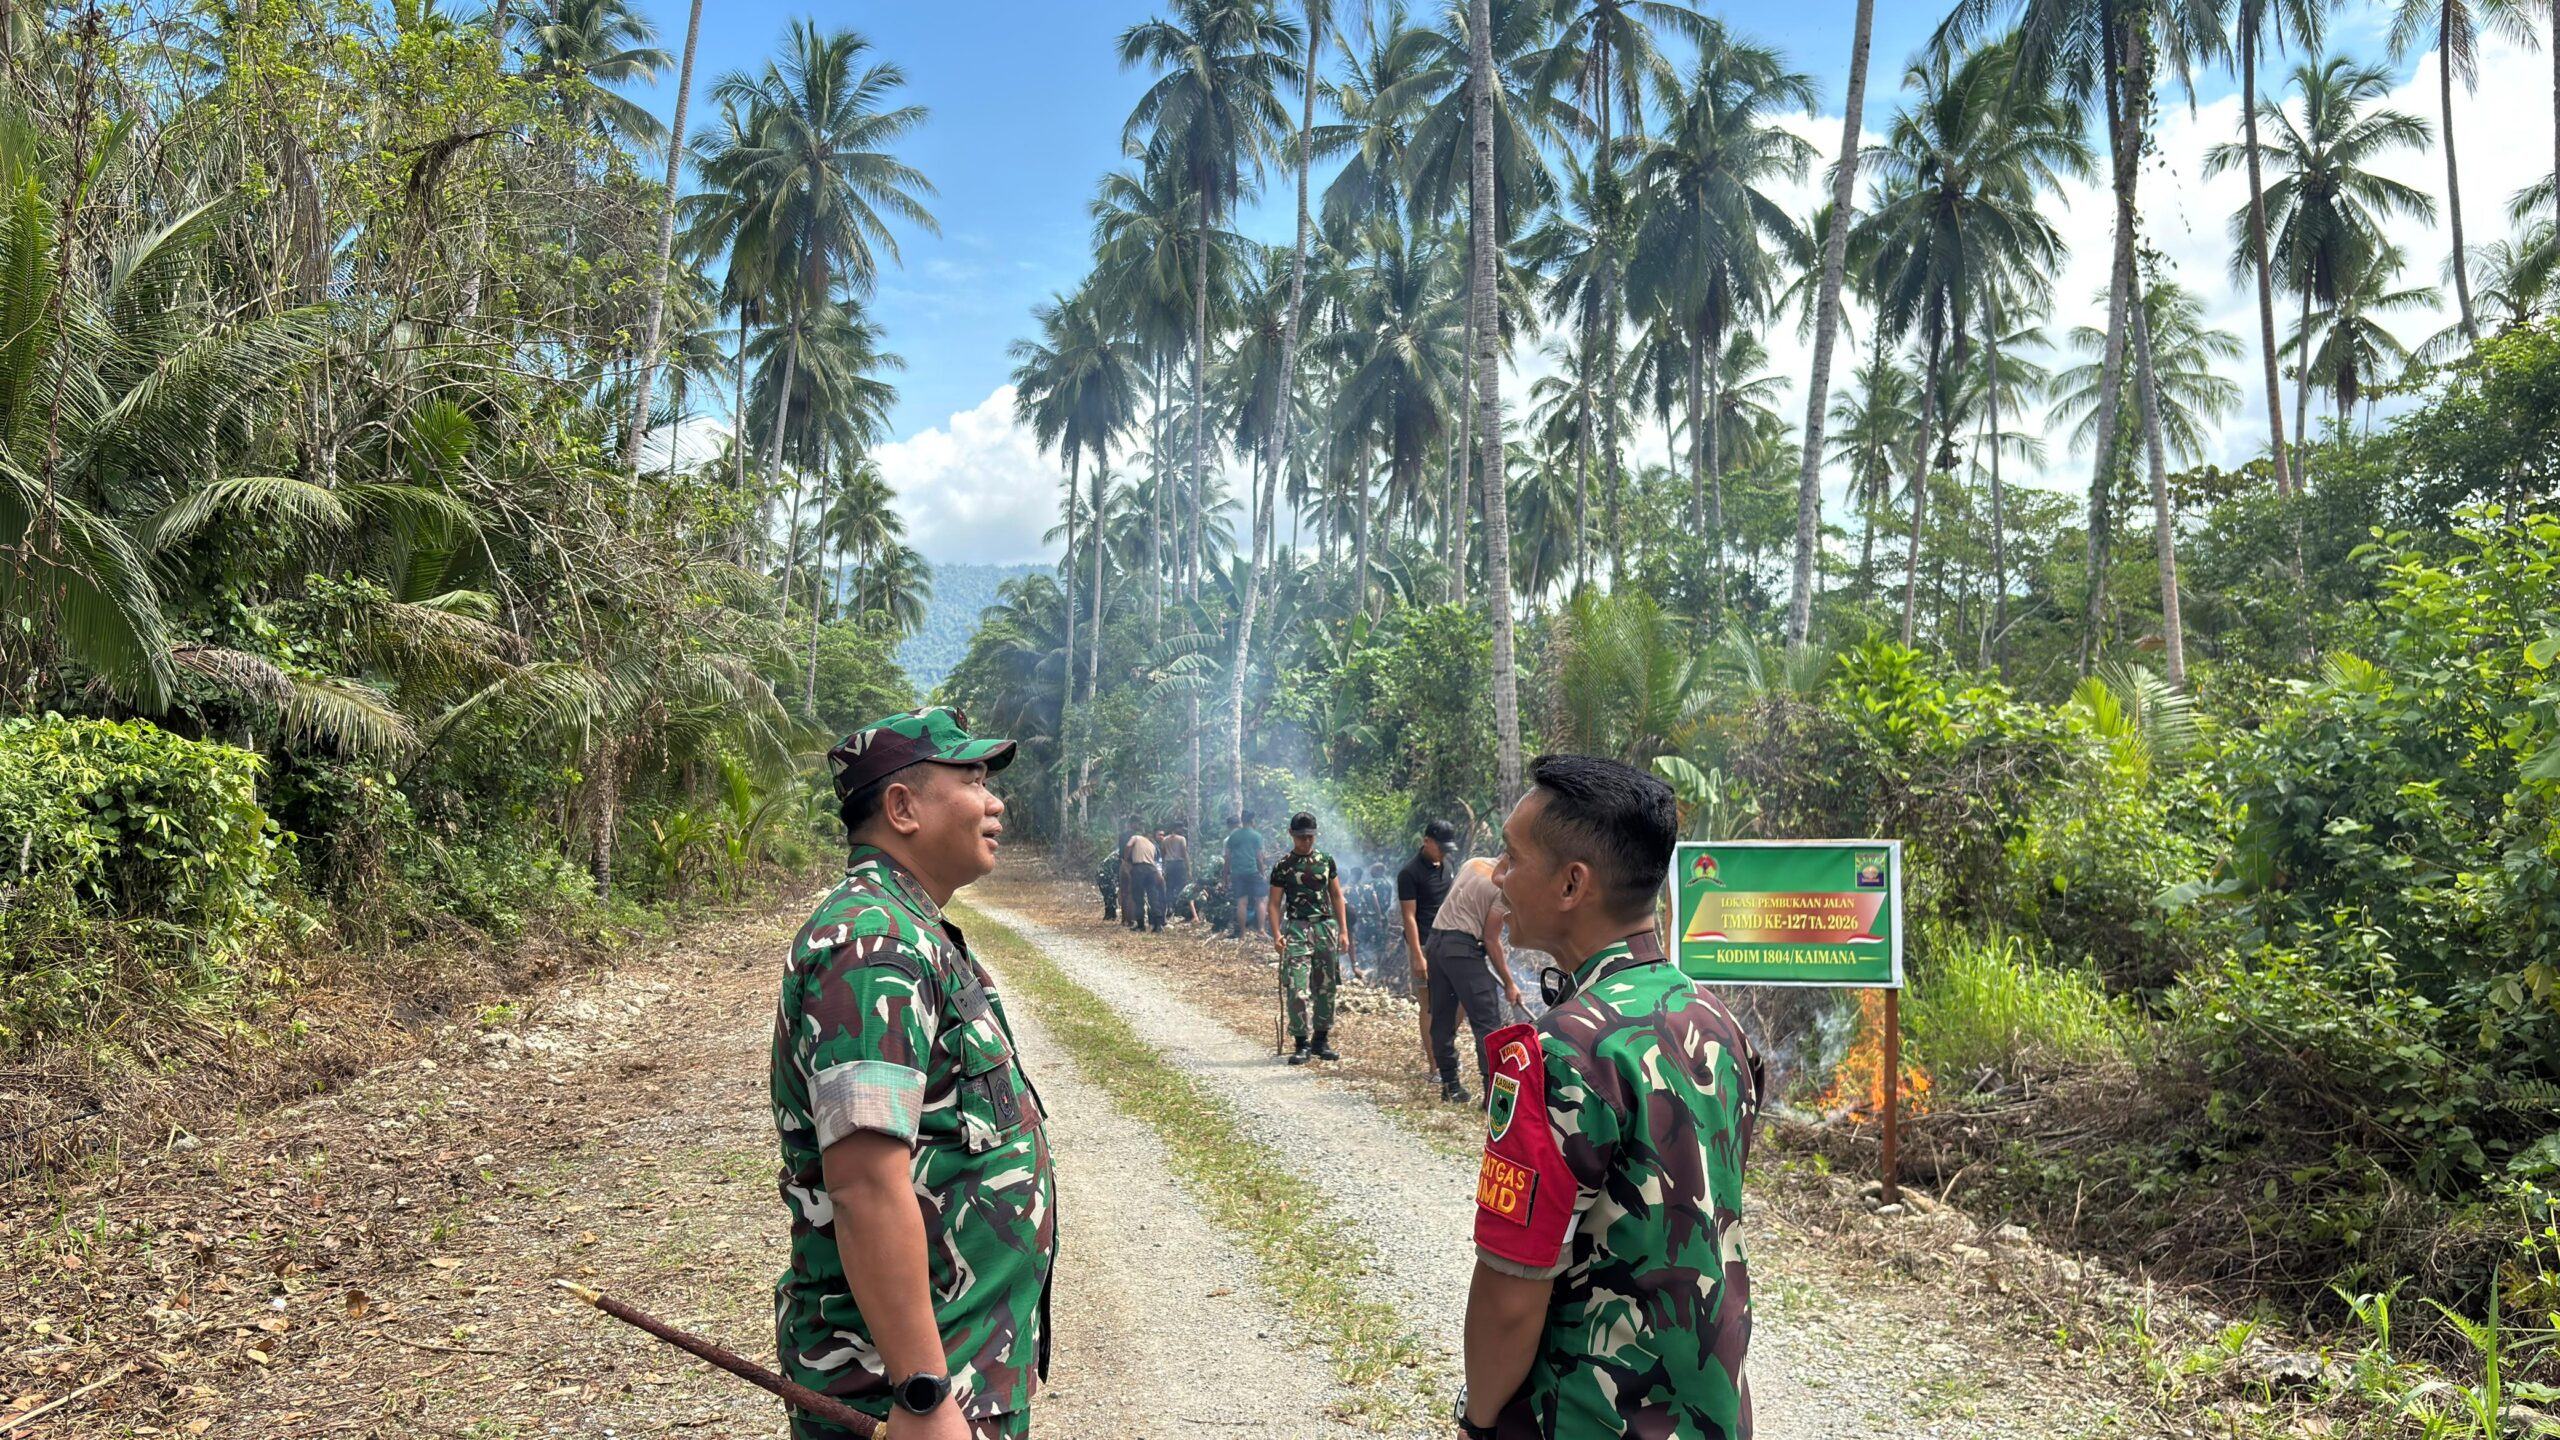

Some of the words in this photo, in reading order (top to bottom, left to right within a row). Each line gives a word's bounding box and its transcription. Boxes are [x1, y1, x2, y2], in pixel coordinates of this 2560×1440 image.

[1721, 897, 1756, 909] LOKASI
[1758, 897, 1821, 909] PEMBUKAAN
[1823, 897, 1855, 909] JALAN
[1721, 914, 1762, 930] TMMD
[1764, 914, 1807, 930] KE-127
[1827, 914, 1859, 930] 2026
[1716, 949, 1760, 964] KODIM
[1763, 948, 1857, 965] 1804/KAIMANA
